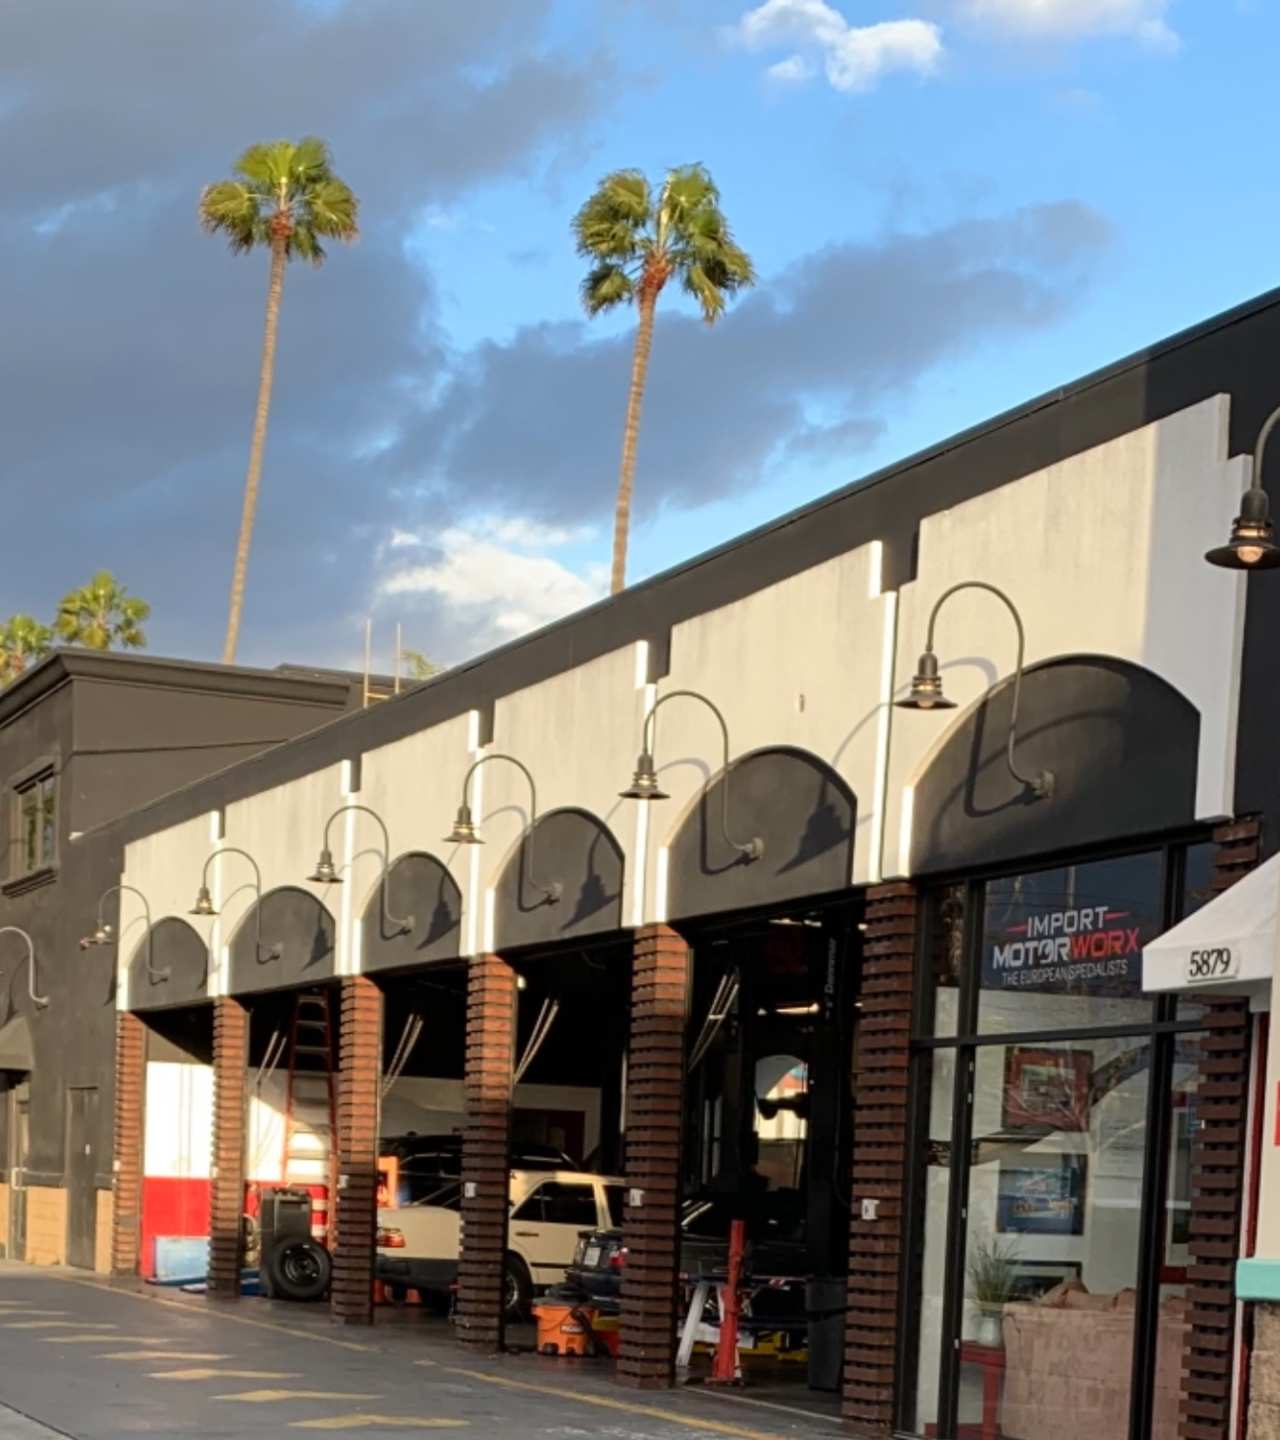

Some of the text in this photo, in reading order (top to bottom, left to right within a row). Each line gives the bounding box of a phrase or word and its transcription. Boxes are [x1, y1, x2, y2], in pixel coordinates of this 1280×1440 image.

[1027, 906, 1108, 938] IMPORT
[1002, 959, 1129, 986] THE EUROPEAN SPECIALISTS
[1189, 947, 1231, 977] 5879
